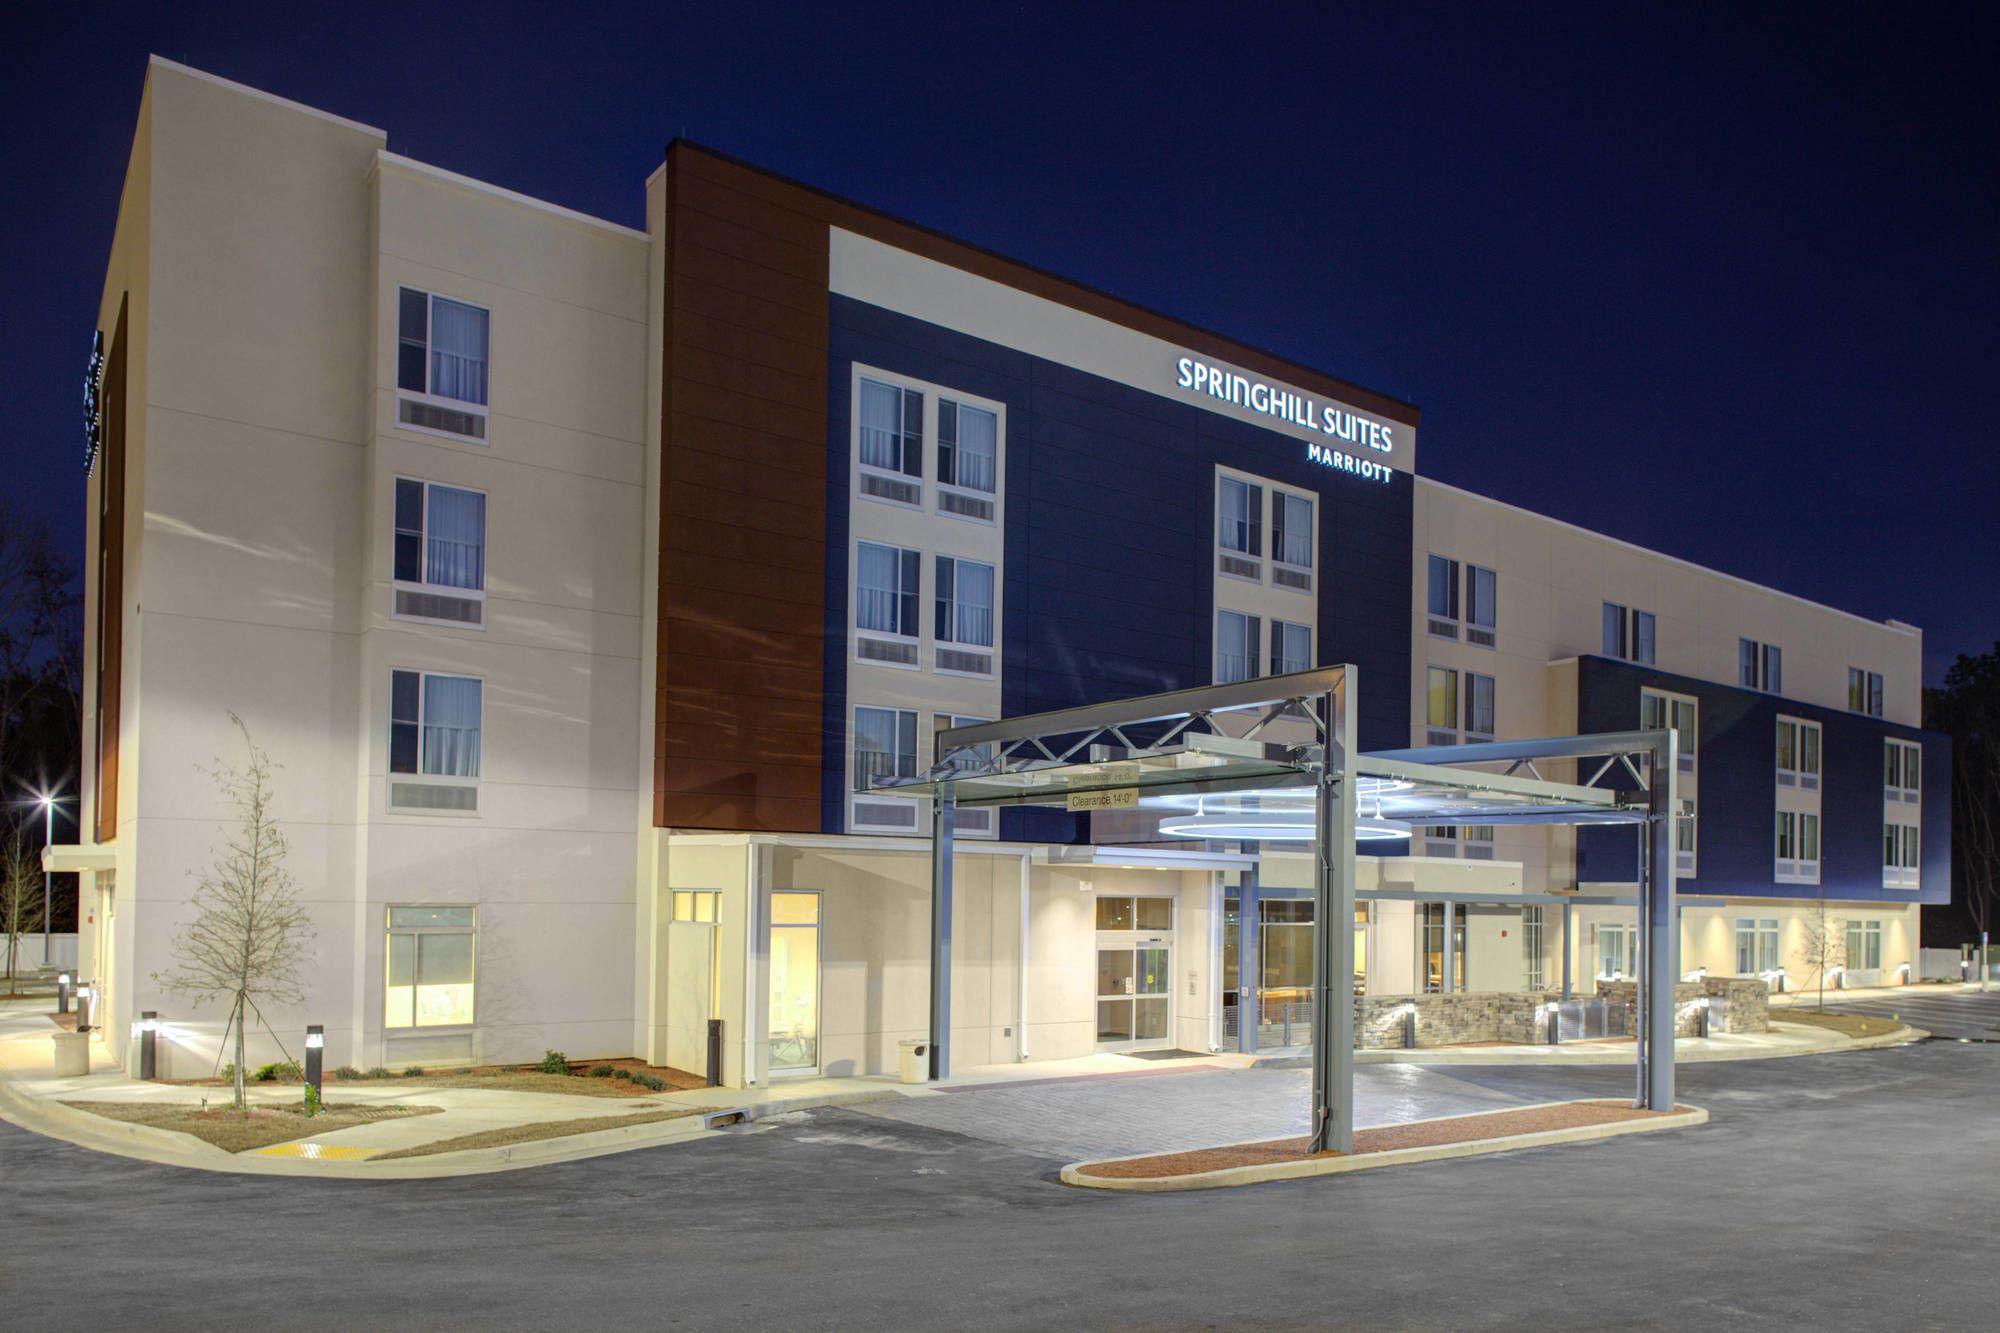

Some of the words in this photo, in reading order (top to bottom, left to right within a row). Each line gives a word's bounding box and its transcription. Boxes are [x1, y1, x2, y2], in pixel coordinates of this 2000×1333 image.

[1176, 357, 1318, 430] SPRINGHILL
[1322, 406, 1392, 452] SUITES
[1307, 443, 1392, 484] MARRIOTT
[1072, 795, 1111, 807] Clearance
